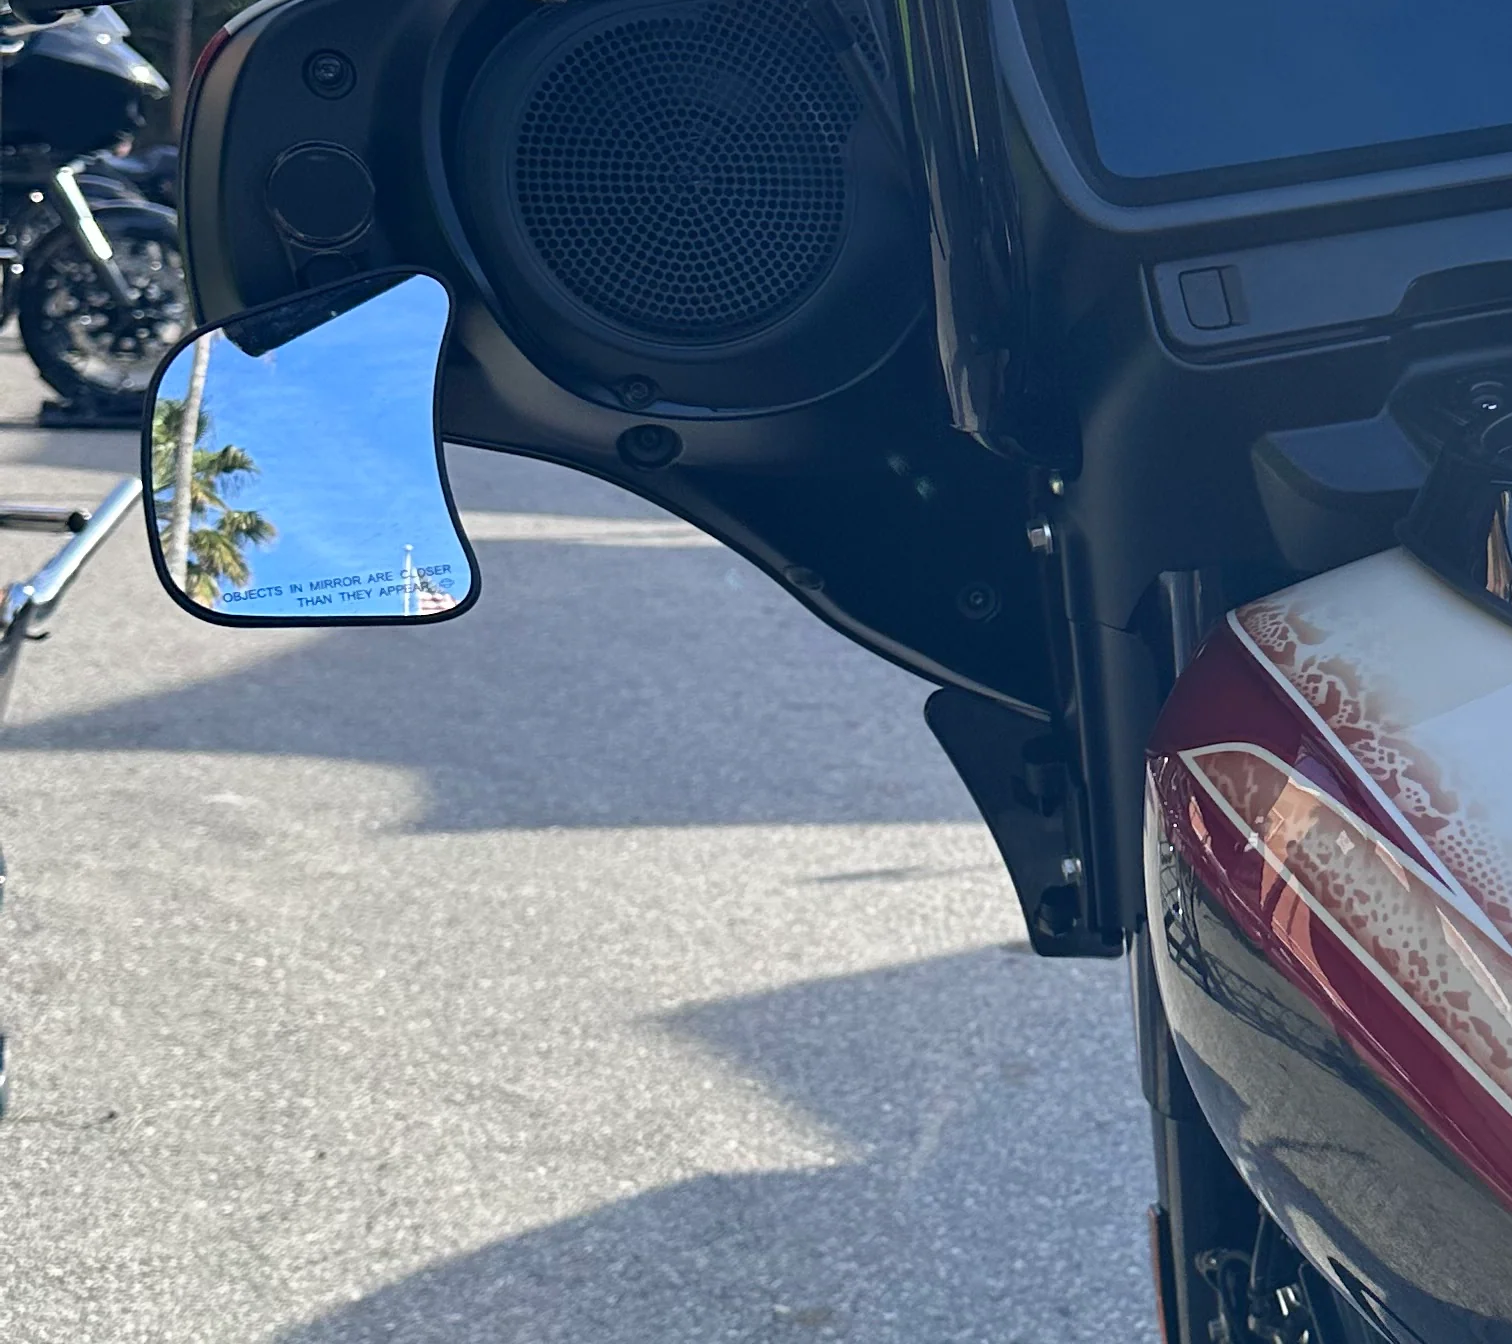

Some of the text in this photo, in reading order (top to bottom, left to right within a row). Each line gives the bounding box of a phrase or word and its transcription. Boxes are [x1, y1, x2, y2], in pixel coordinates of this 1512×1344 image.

[222, 564, 452, 603] OBJECTS IN MIRROR ARE CLOSER
[297, 581, 431, 608] THAN THEY APPEAR
